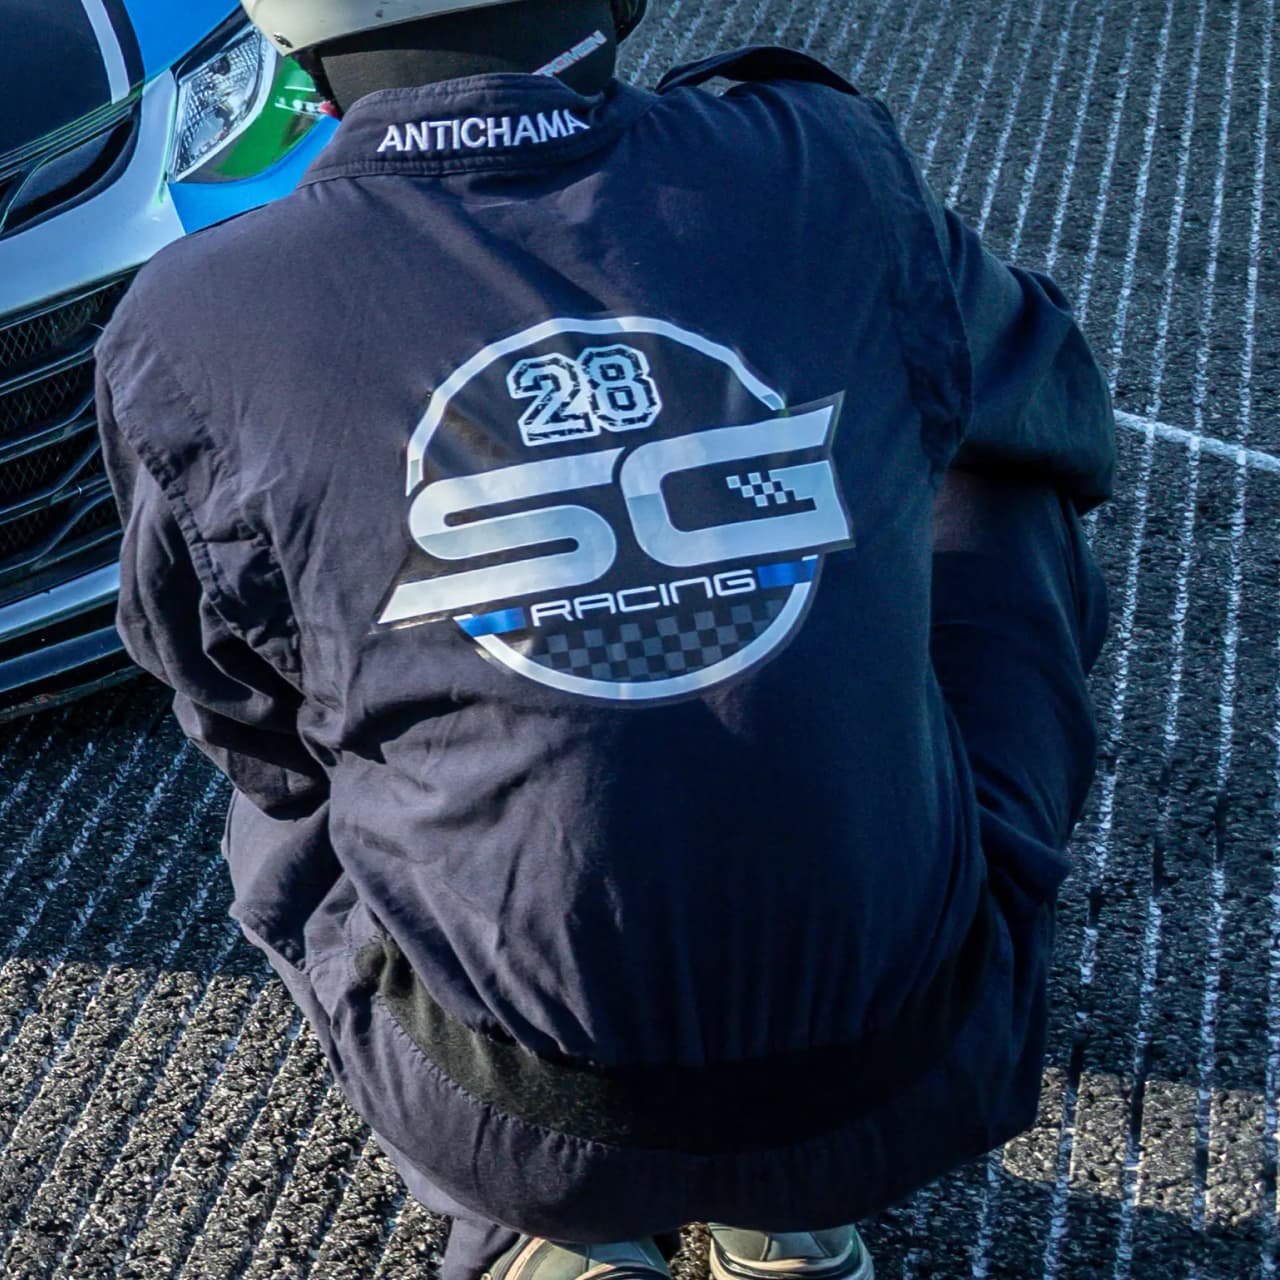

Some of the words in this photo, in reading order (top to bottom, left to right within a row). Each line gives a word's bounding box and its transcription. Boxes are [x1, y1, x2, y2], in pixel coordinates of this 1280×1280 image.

[506, 343, 663, 447] 28
[377, 404, 851, 625] SG
[531, 570, 758, 628] RACING
